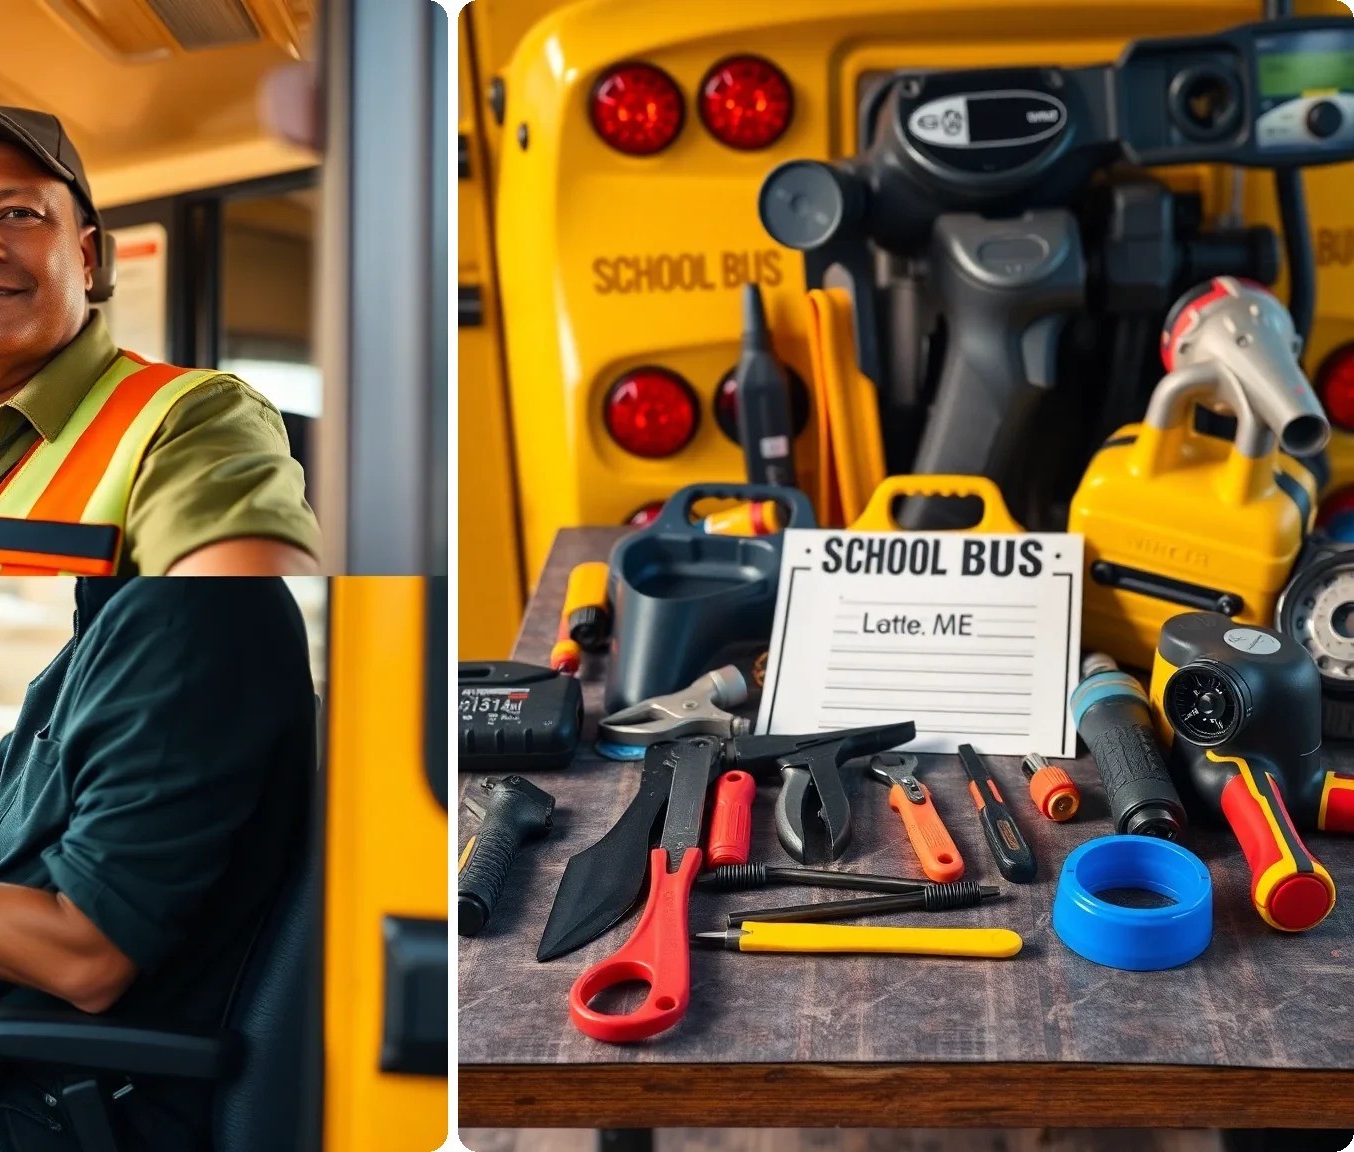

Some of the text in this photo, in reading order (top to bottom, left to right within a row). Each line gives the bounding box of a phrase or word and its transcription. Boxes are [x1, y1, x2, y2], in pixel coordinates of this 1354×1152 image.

[592, 250, 782, 295] SCHOOL BUS
[821, 536, 1044, 578] SCHOOL BUS
[932, 613, 974, 637] ME
